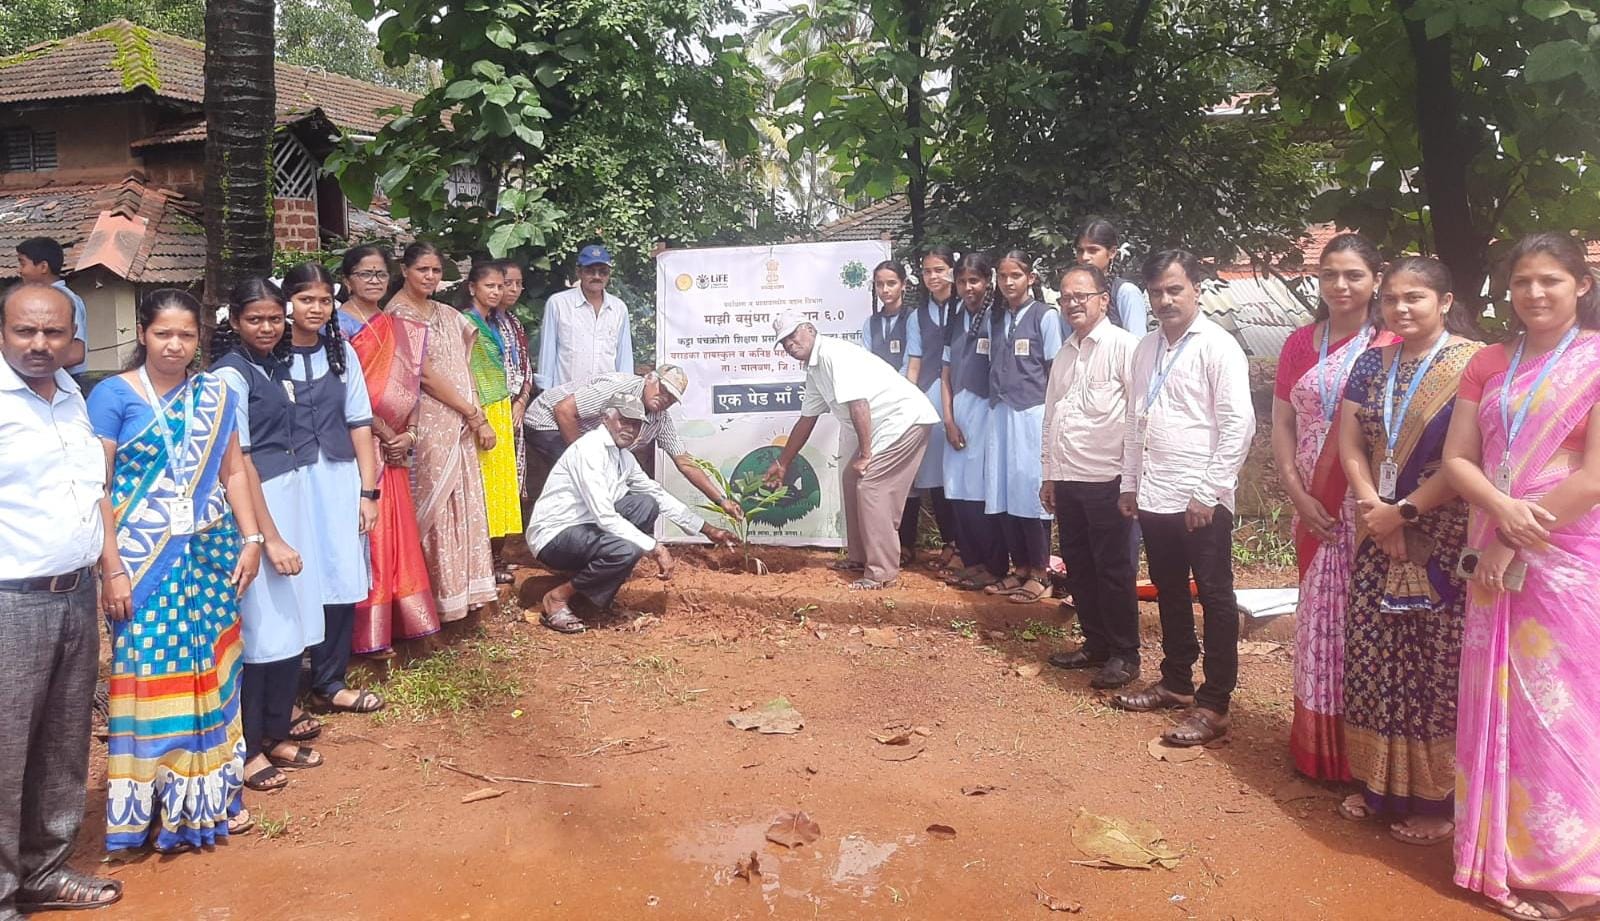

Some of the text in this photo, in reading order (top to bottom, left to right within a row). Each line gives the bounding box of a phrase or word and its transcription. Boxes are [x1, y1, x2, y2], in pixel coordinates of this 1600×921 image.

[711, 274, 728, 283] LiFE
[704, 312, 730, 326] माझी
[735, 310, 770, 327] वसुंधरा
[734, 333, 758, 344] शिक्षण
[717, 394, 742, 410] एक
[747, 388, 769, 405] पेड
[774, 386, 792, 404] माँ
